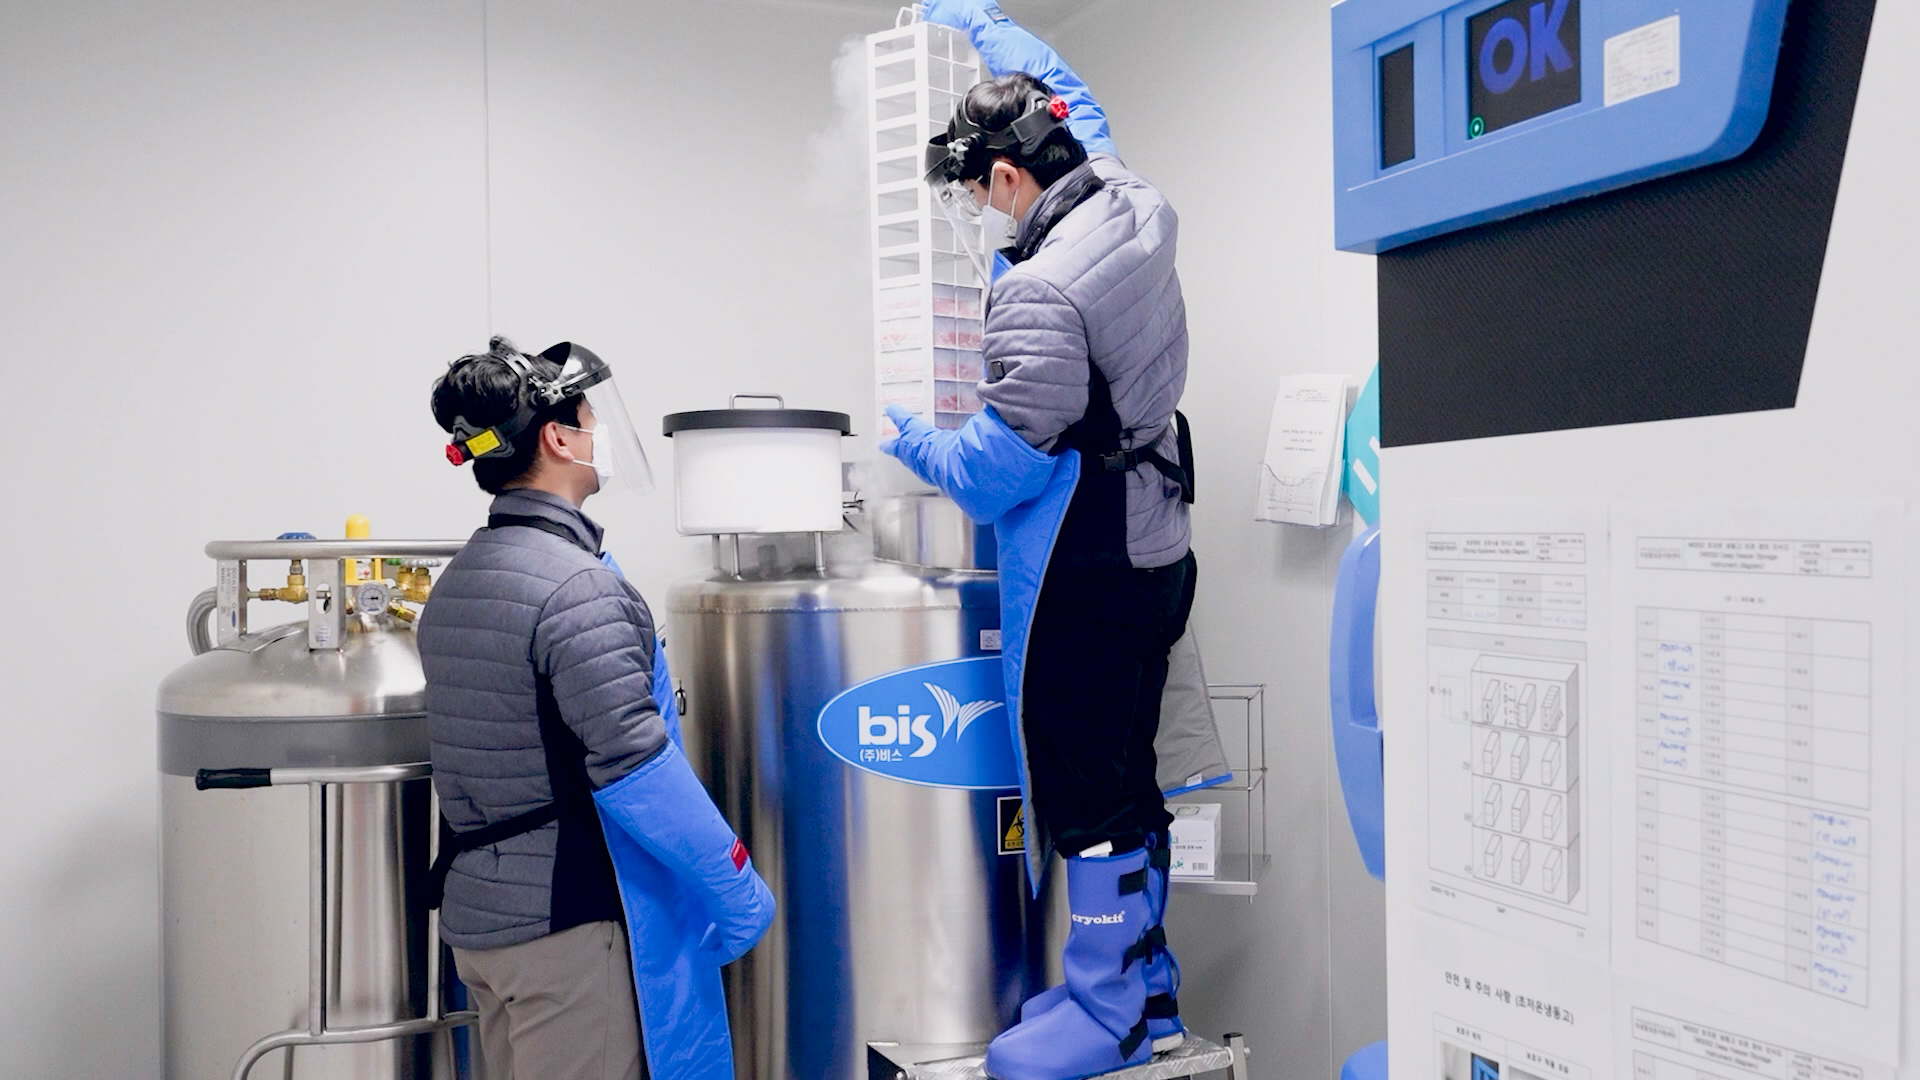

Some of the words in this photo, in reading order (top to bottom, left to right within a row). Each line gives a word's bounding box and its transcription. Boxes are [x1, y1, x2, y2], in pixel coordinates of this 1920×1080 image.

[1480, 0, 1574, 94] OK
[858, 705, 937, 757] bis
[859, 748, 903, 762] (주)비스
[1444, 970, 1460, 987] 안전
[1464, 977, 1471, 991] 및
[1475, 982, 1491, 997] 주의
[1495, 989, 1511, 1004] 사항
